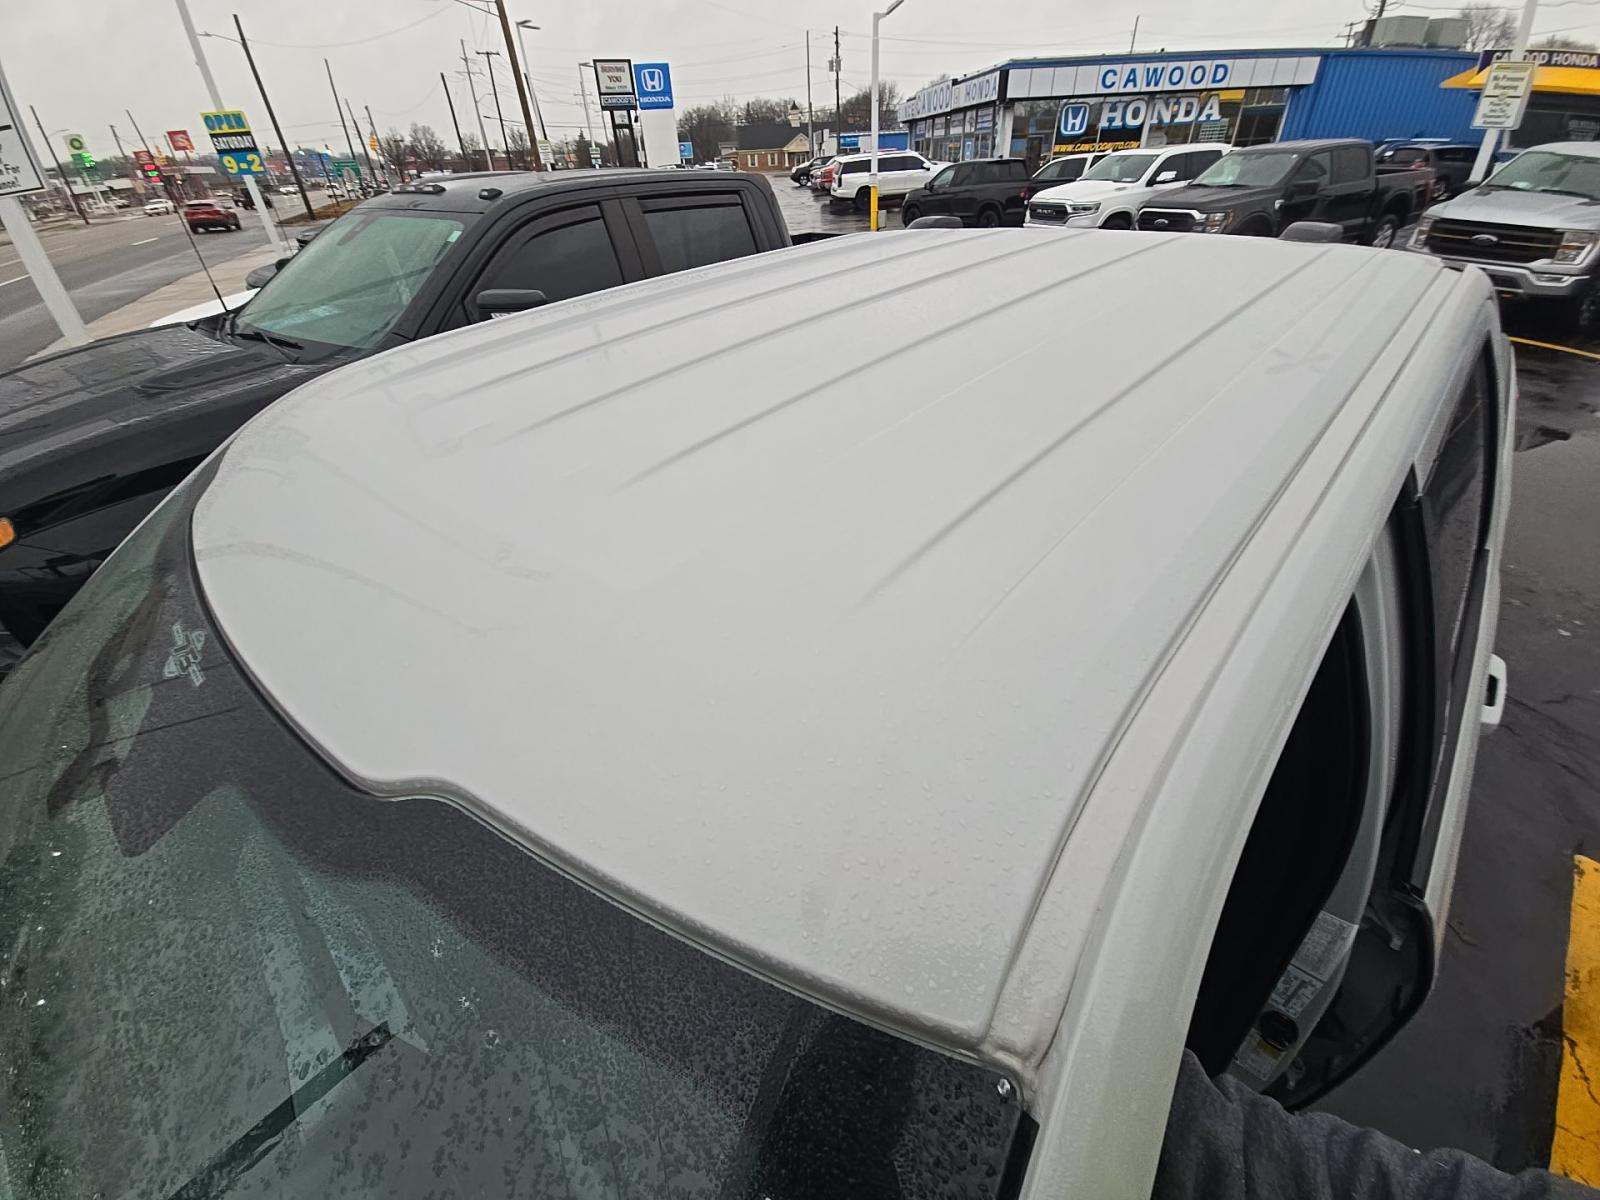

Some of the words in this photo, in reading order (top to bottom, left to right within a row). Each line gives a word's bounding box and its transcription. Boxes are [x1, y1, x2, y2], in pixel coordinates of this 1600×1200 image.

[1493, 51, 1549, 64] CAOOD
[1551, 54, 1598, 66] HONDA
[607, 75, 622, 83] YOU
[1101, 64, 1229, 89] CAWOOD
[964, 76, 998, 99] HONDA
[1099, 93, 1222, 129] HONDA
[203, 113, 247, 131] OPEN
[213, 134, 255, 150] SATURDAY
[222, 153, 265, 174] 9-2
